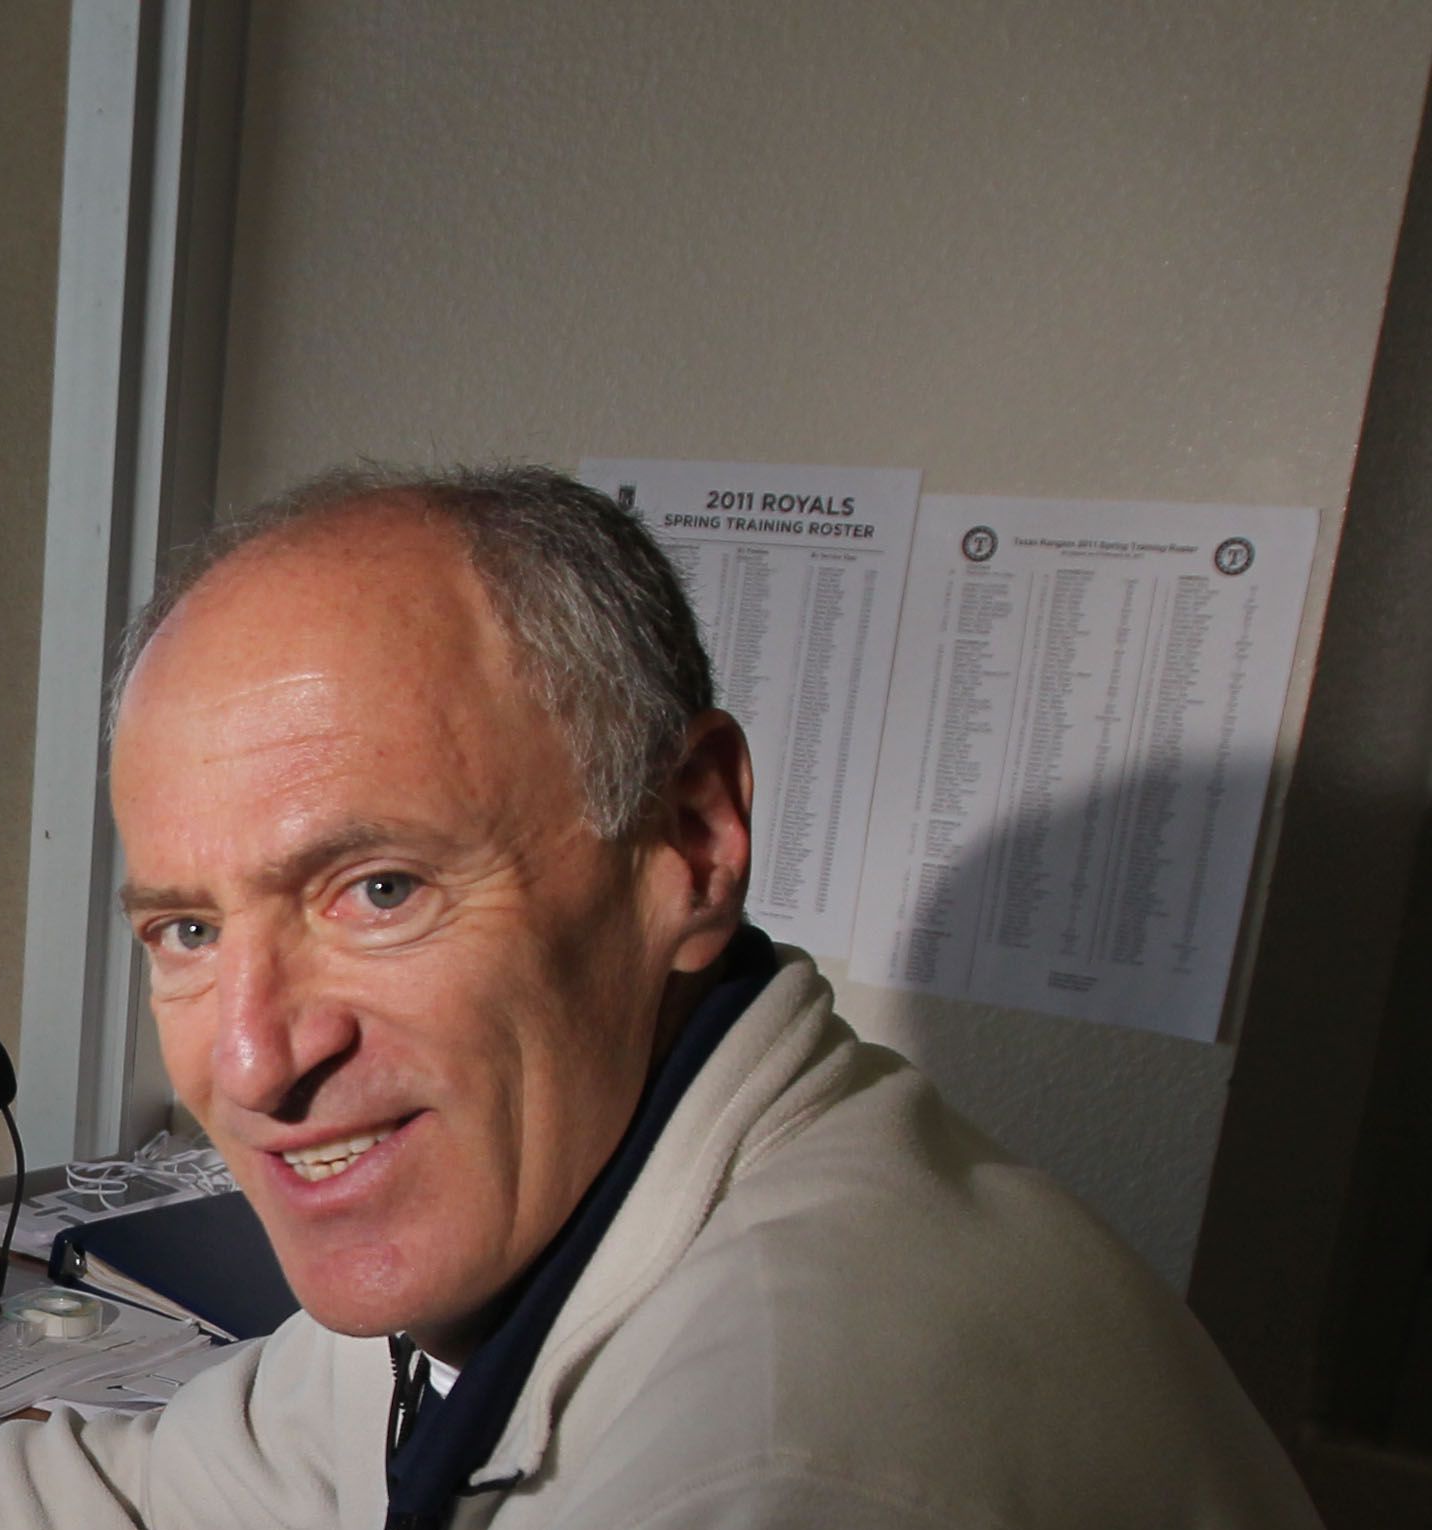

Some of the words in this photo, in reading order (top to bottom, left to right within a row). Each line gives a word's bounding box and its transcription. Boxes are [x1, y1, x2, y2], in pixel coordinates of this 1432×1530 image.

[706, 490, 754, 511] 2011
[761, 493, 856, 517] ROYALS
[663, 513, 721, 529] SPRING
[726, 516, 805, 535] TRAINING
[807, 521, 876, 539] ROSTER
